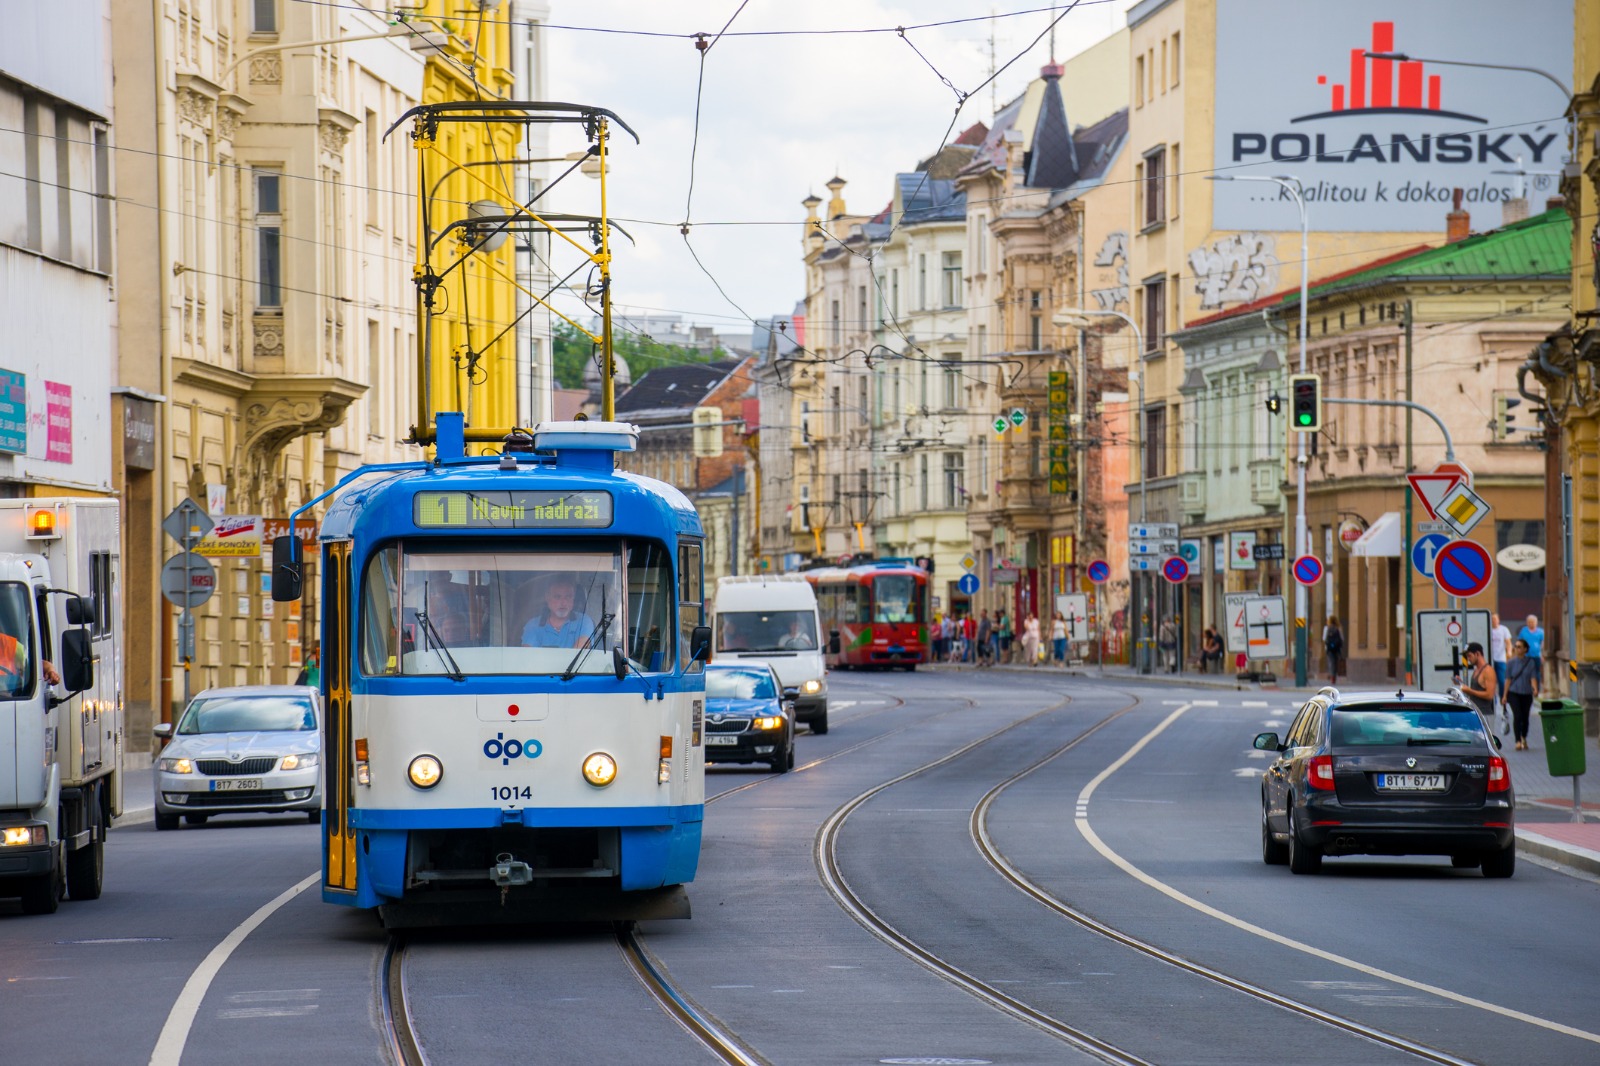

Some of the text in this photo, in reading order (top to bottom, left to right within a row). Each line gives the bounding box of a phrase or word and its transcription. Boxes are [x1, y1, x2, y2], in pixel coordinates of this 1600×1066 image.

[1232, 125, 1558, 163] POLANSKÝ
[1397, 180, 1528, 203] dokoalosi
[437, 496, 600, 523] 1 Hlavní nádraží
[218, 540, 257, 548] PONOŽKY
[483, 732, 543, 766] dpo
[216, 779, 258, 790] 8T7 2603
[1386, 775, 1440, 787] 8T1 6717
[491, 786, 533, 800] 1014
